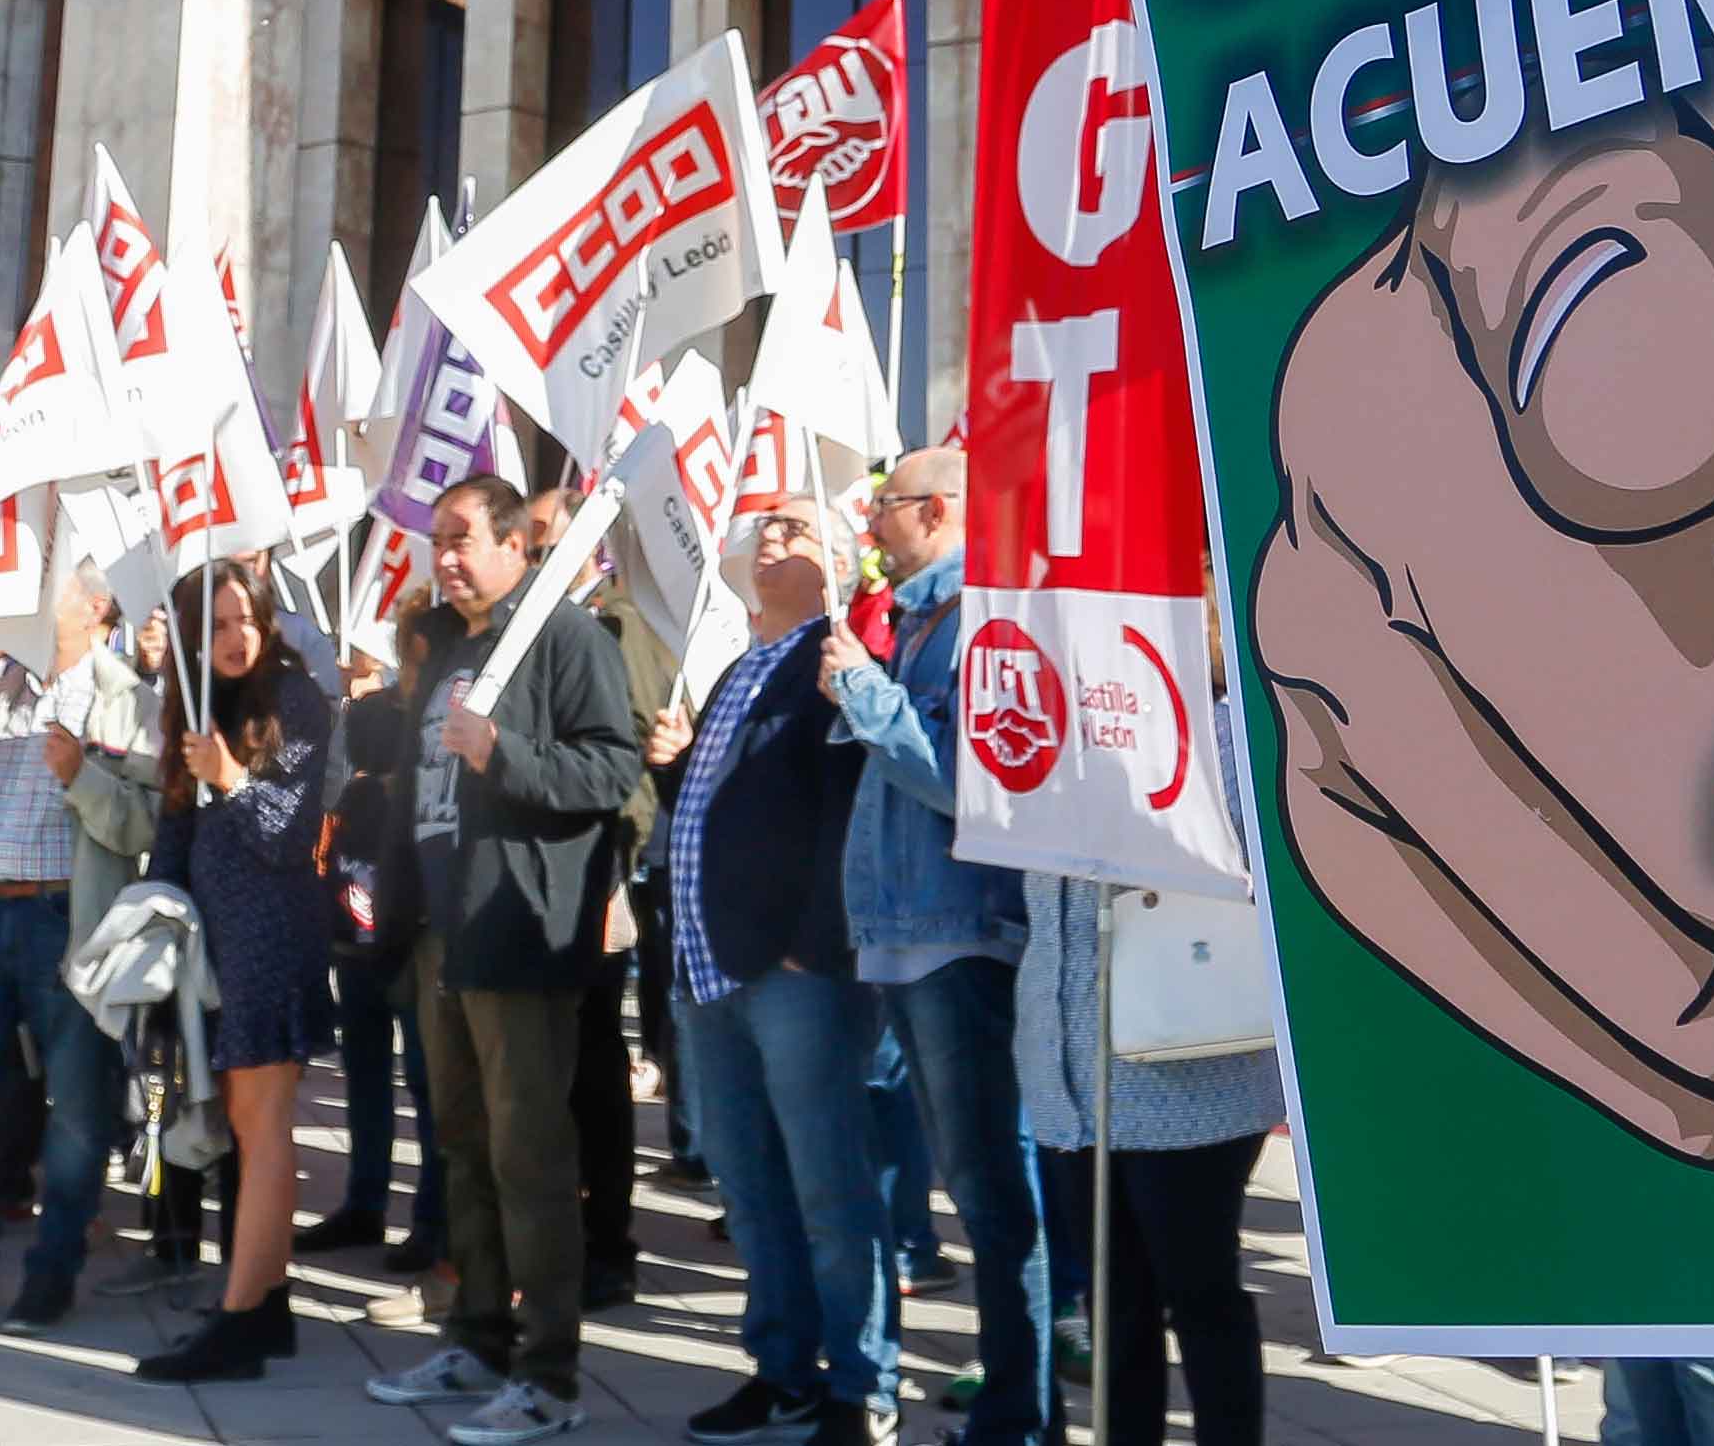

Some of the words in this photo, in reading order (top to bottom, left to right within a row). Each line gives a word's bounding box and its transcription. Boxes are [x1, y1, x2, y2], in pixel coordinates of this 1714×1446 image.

[506, 121, 722, 346] CCOO
[662, 229, 733, 278] León
[970, 647, 1042, 715] UGT
[1078, 680, 1137, 715] astilla
